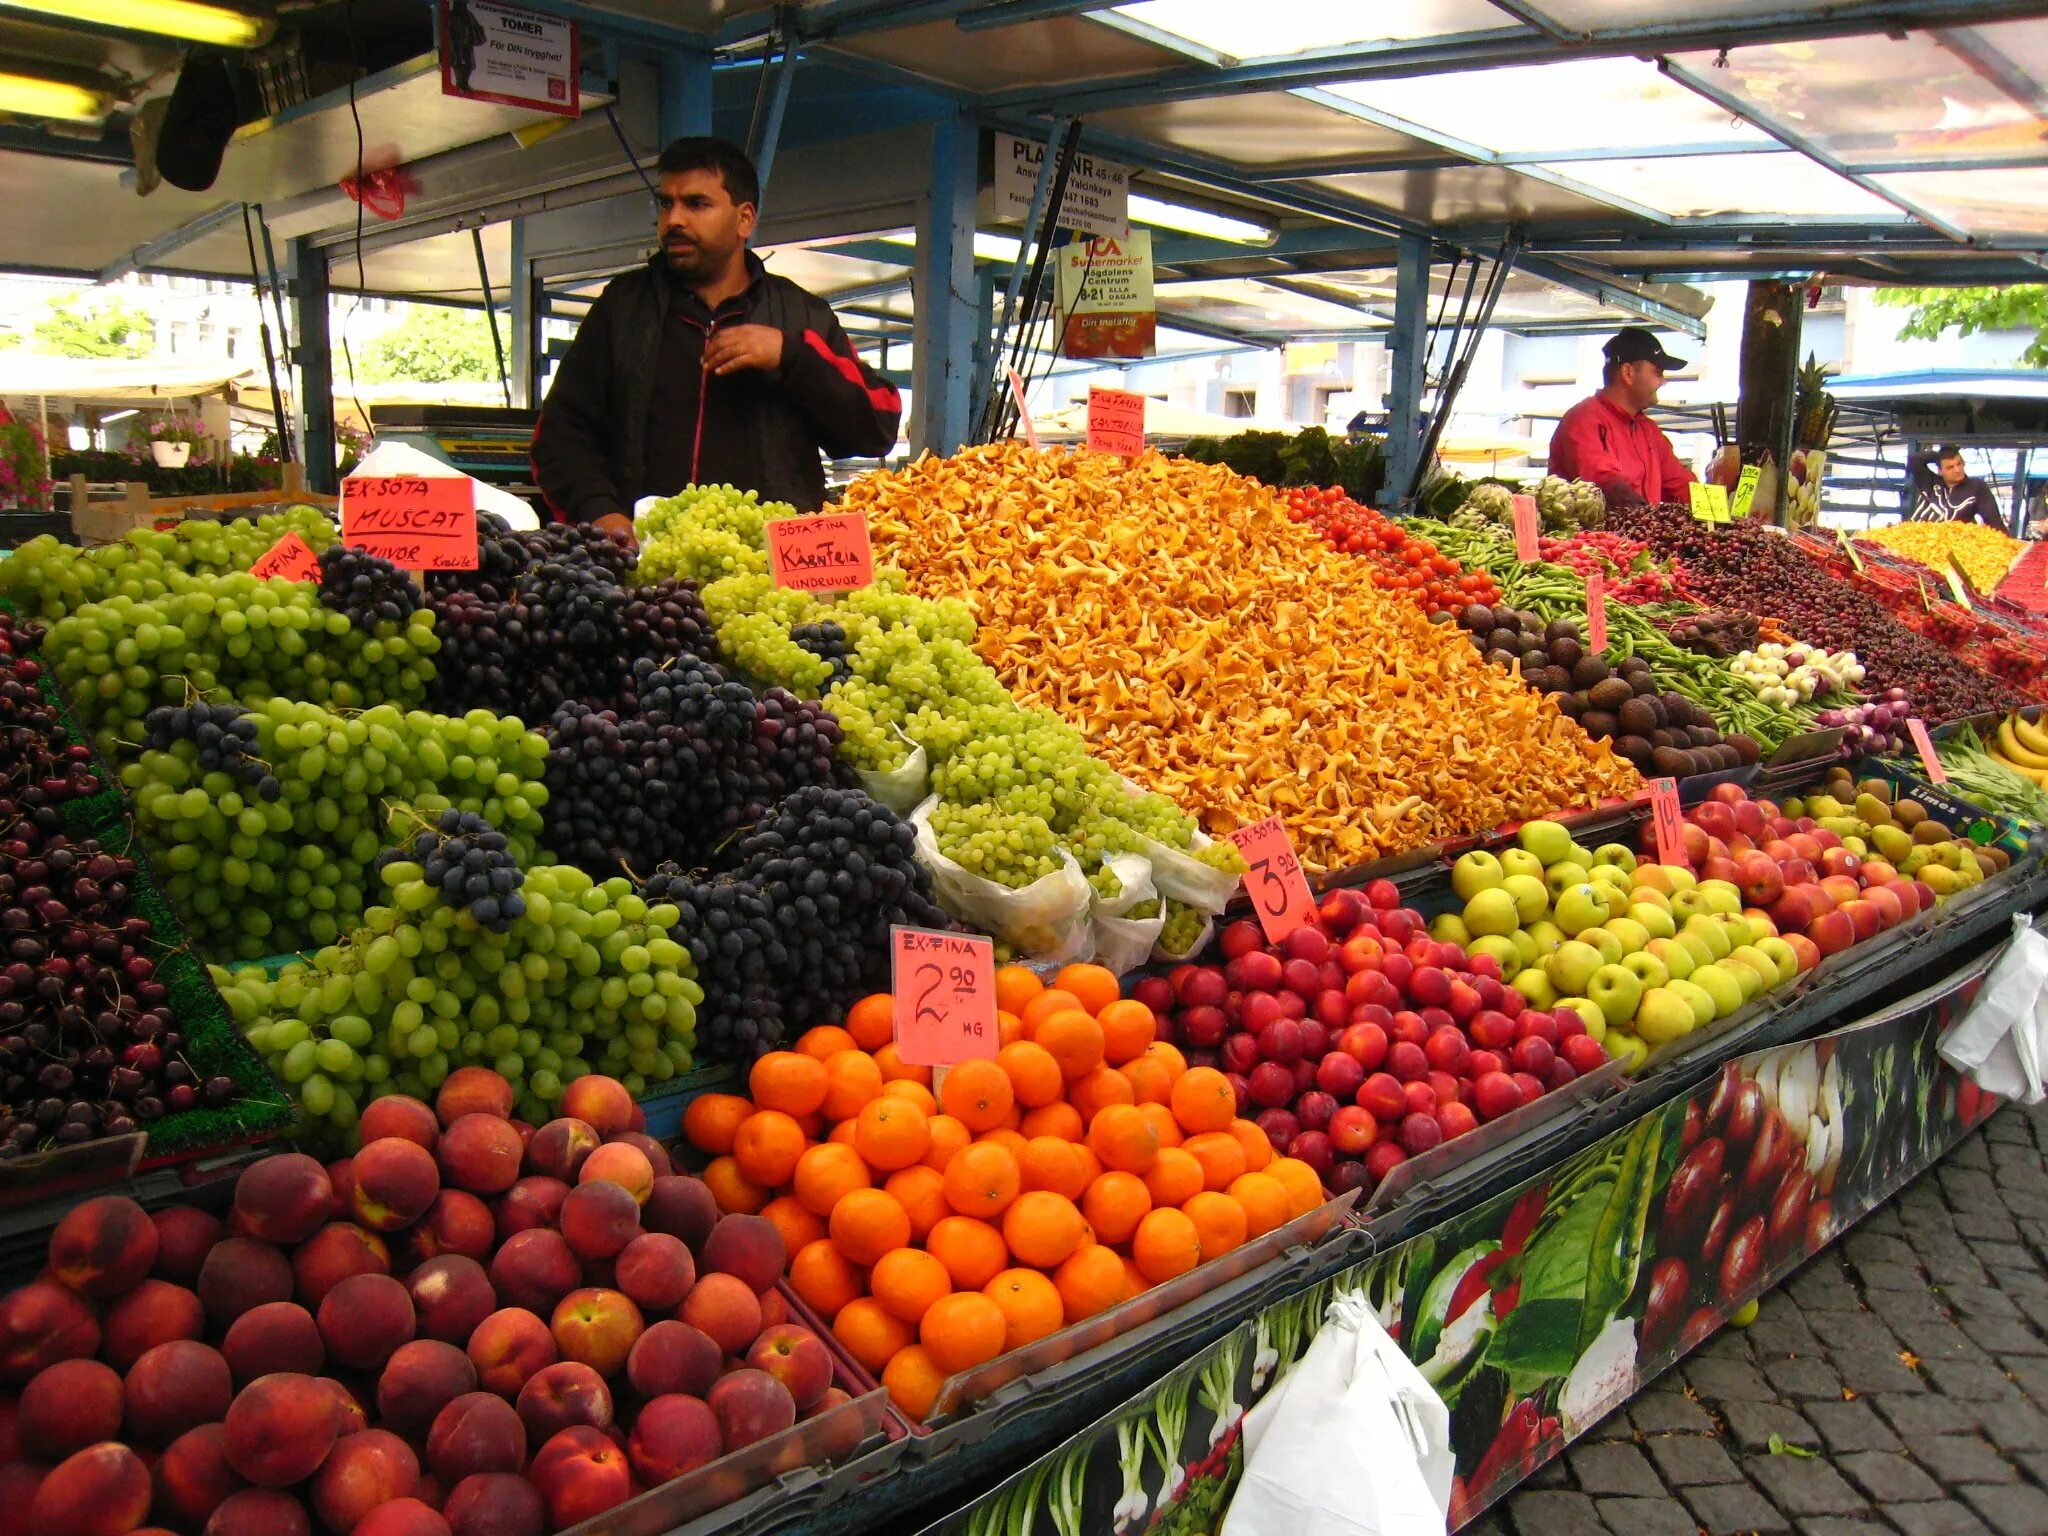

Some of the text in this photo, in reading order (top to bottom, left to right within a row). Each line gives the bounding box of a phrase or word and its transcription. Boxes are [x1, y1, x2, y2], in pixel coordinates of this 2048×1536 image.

[501, 17, 543, 35] TOMER
[490, 39, 562, 62] För DIN trygghet!
[1013, 141, 1064, 169] PLAS
[1071, 156, 1093, 178] NR
[1085, 236, 1122, 257] ICA
[1071, 255, 1142, 268] Supermarket
[1088, 277, 1129, 286] Centrum
[1082, 318, 1097, 327] Din
[353, 508, 465, 530] MUSCAT
[811, 519, 848, 532] FINA
[786, 575, 861, 589] VINDRUVOR
[1909, 787, 1957, 814] Limes
[963, 1022, 983, 1038] HG
